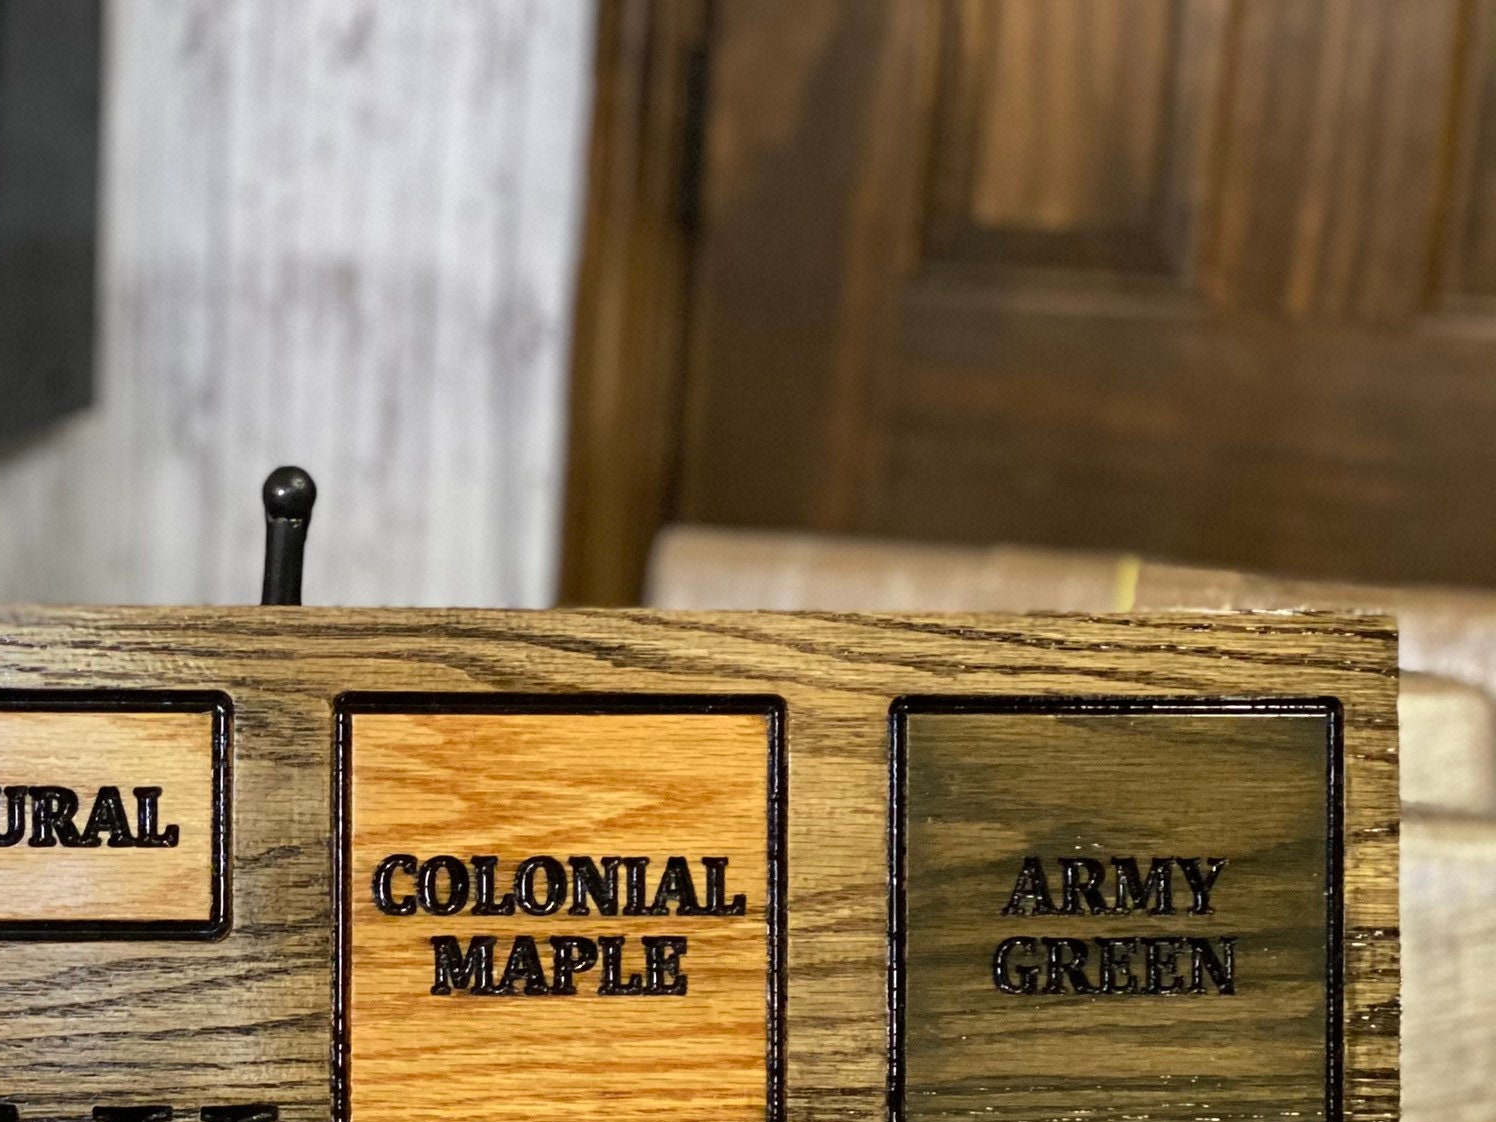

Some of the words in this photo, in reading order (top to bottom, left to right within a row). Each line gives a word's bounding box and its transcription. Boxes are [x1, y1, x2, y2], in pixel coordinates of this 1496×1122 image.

[372, 853, 747, 917] COLONIAL
[1002, 856, 1229, 916] ARMY
[430, 934, 689, 996] MAPLE
[992, 935, 1238, 996] GREEN
